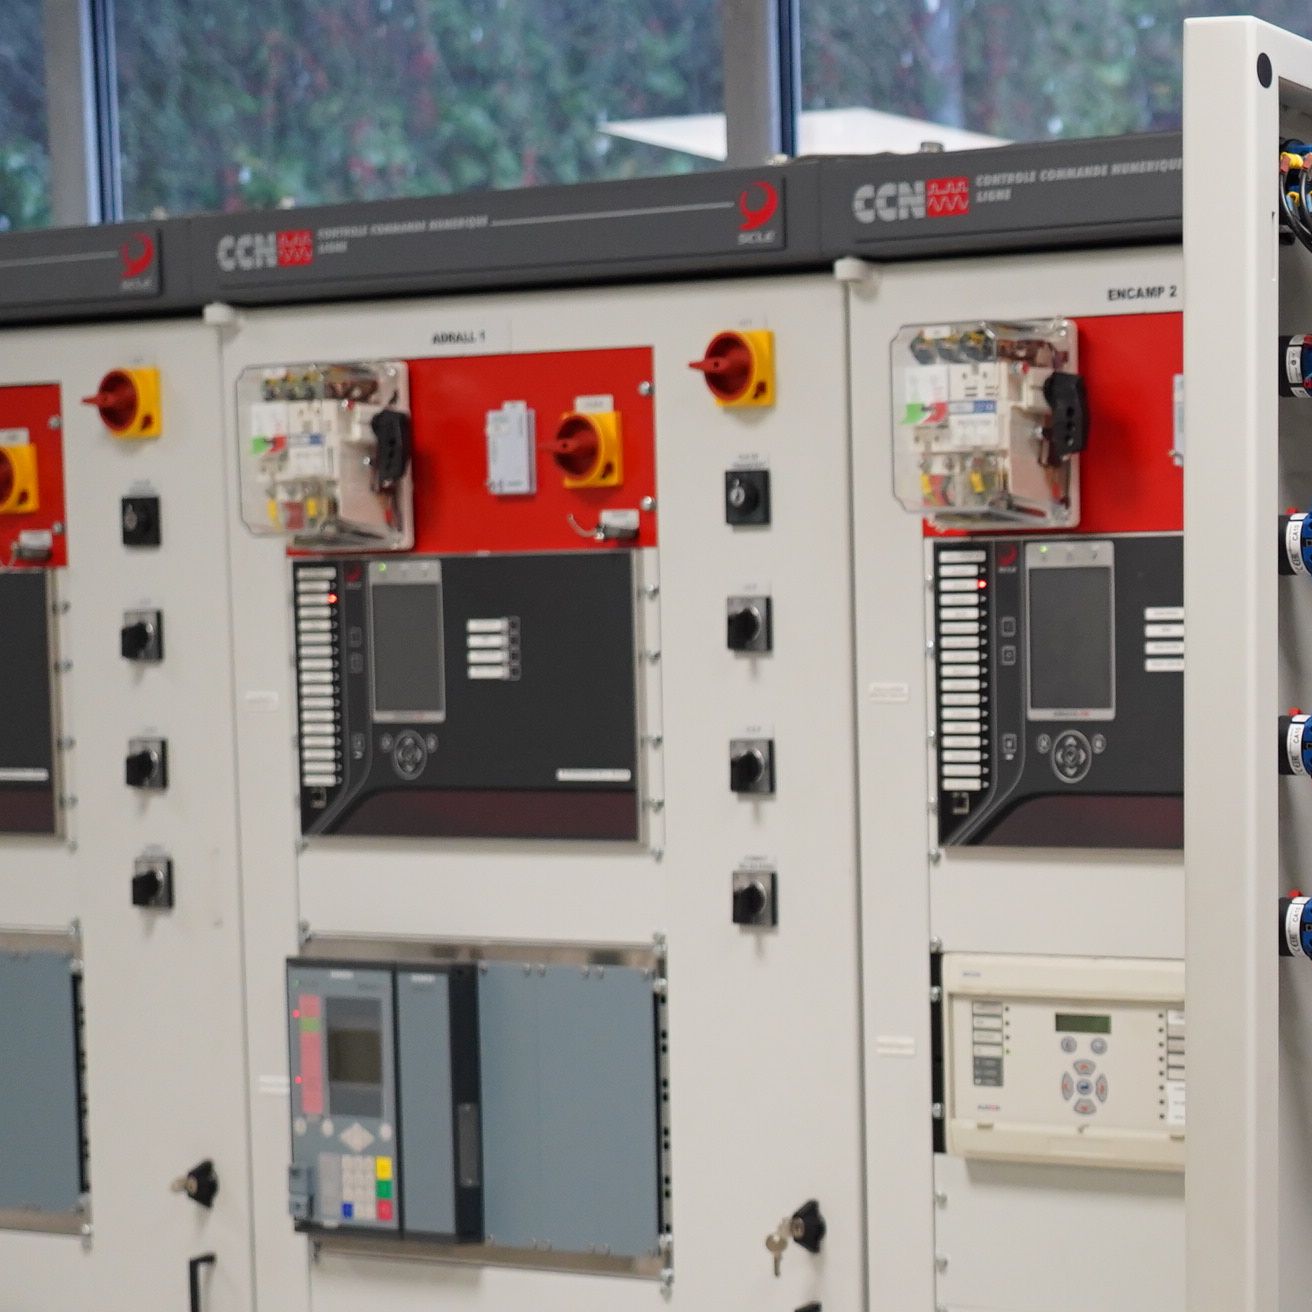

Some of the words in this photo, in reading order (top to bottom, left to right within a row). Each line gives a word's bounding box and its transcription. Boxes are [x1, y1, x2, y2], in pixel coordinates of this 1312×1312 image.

[976, 170, 1036, 187] CONTROLE
[1040, 164, 1108, 182] COMMANDE
[854, 180, 927, 223] CCN
[976, 188, 1012, 204] LIGNE
[217, 232, 277, 272] CCN
[1108, 286, 1165, 302] ENCAMP
[1170, 285, 1178, 299] 2
